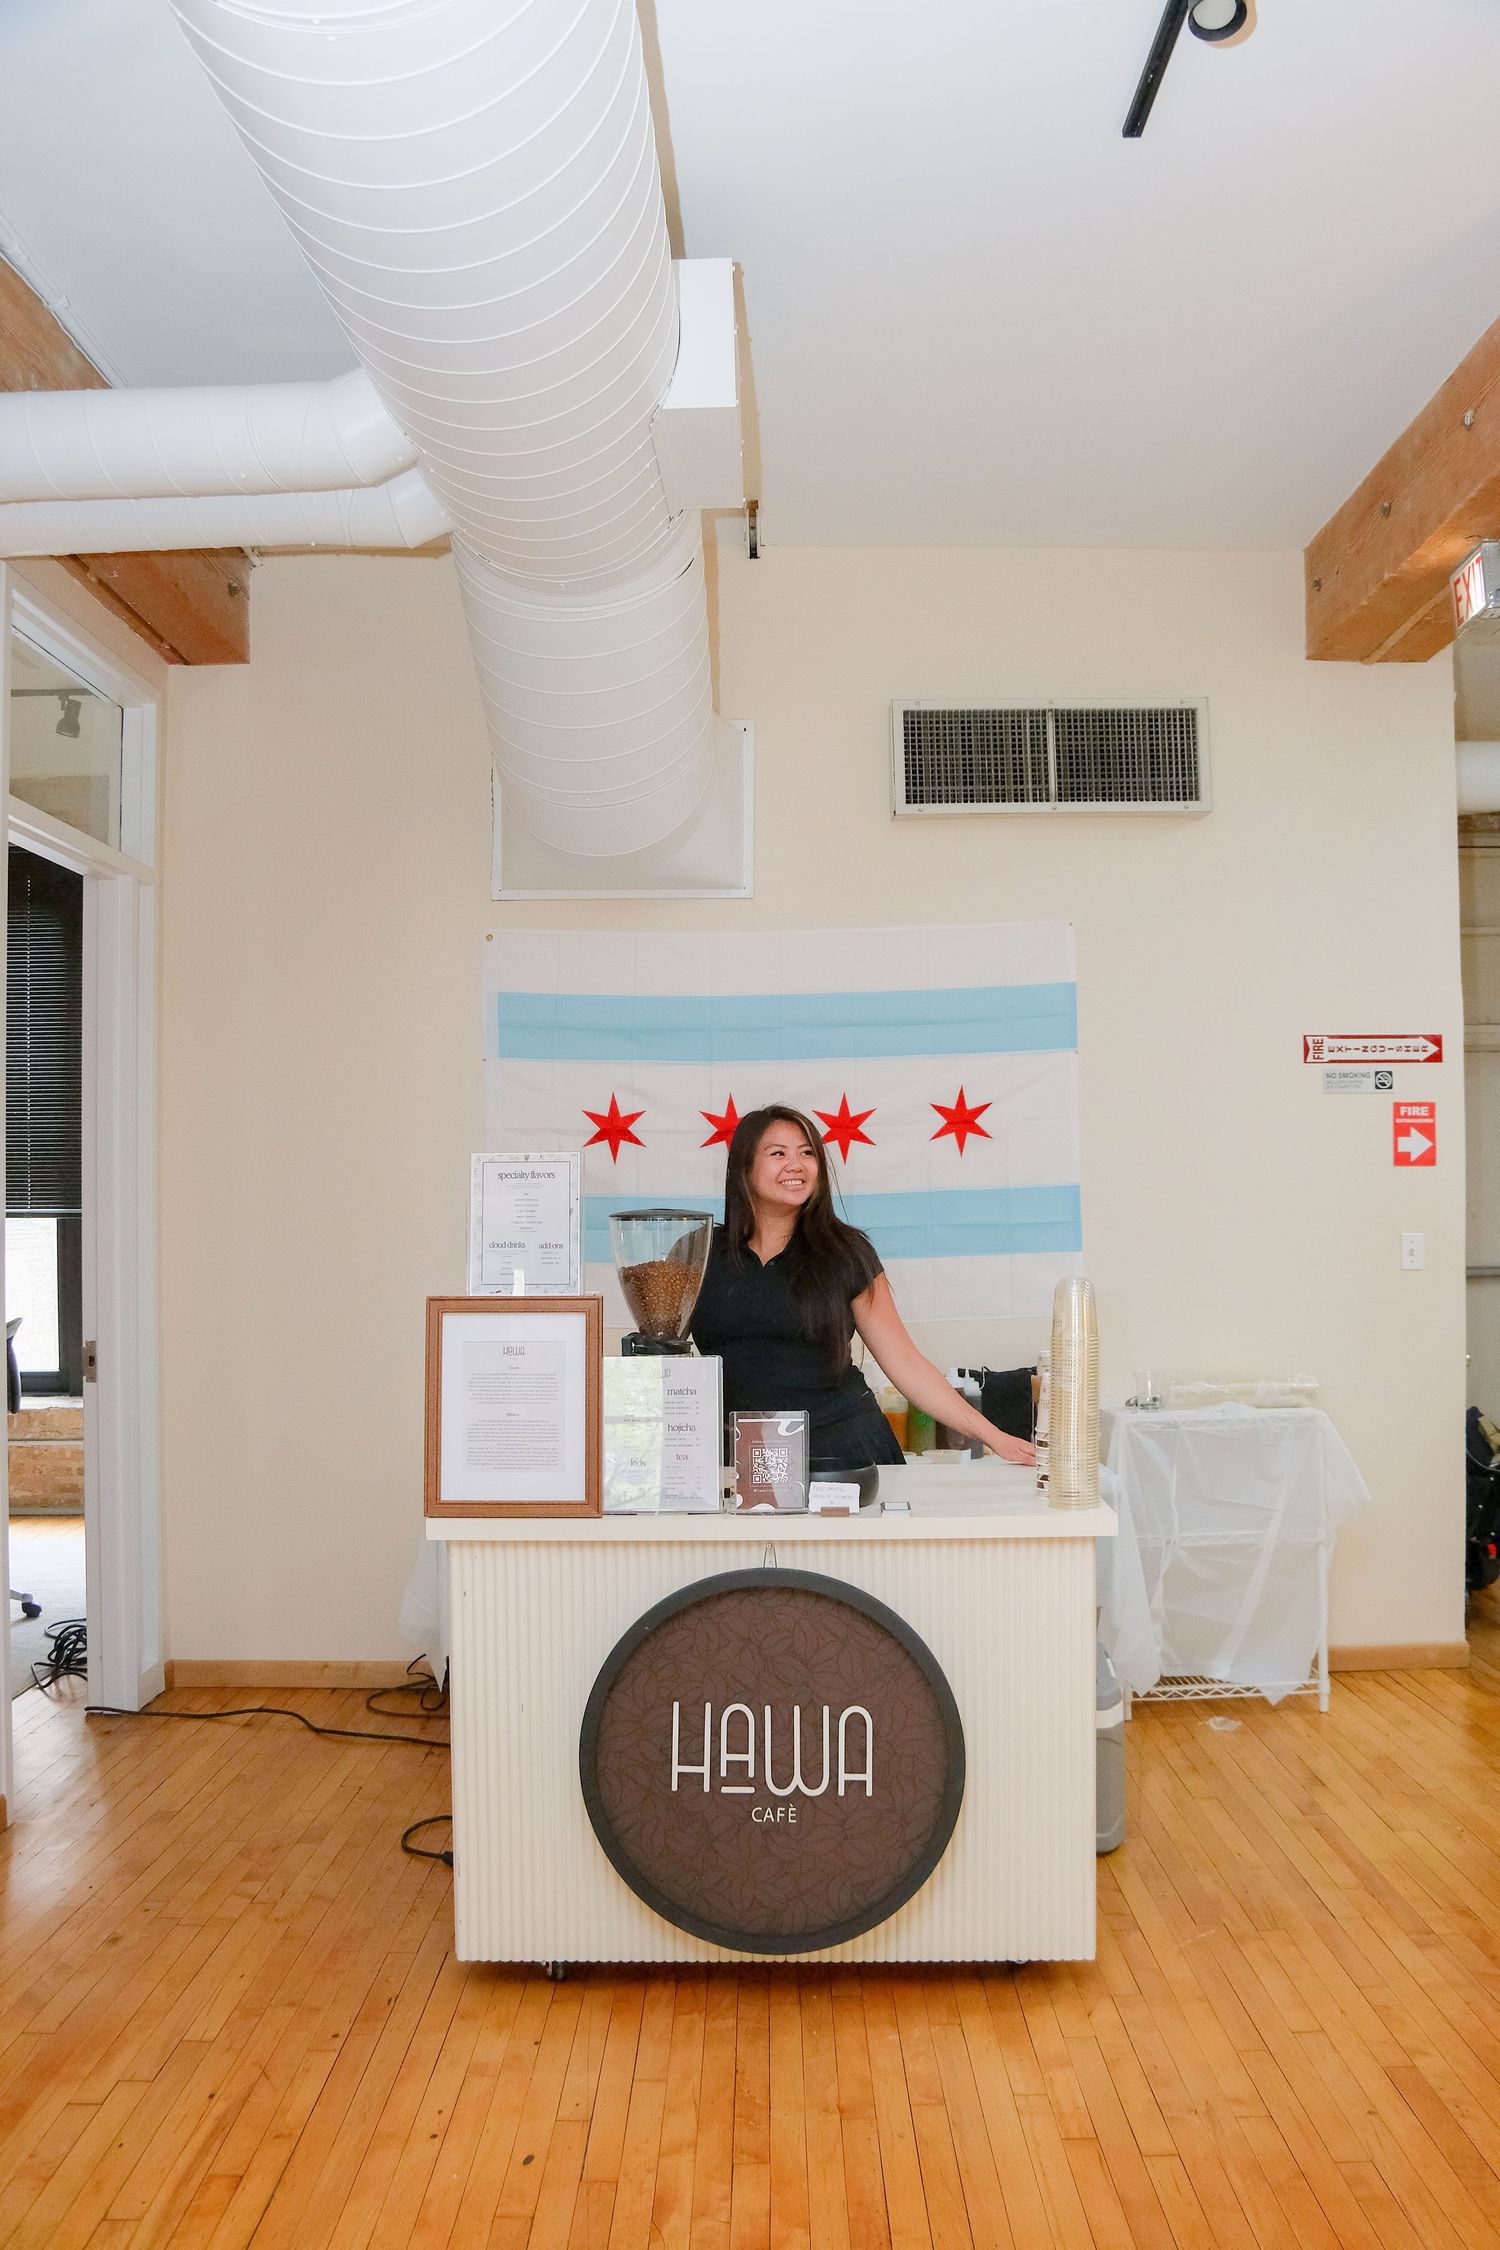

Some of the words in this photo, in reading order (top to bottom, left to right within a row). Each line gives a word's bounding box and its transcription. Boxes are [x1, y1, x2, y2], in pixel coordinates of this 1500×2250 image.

[1453, 556, 1484, 627] EXIT
[1313, 1038, 1324, 1060] FIRE
[1328, 1045, 1428, 1053] EXTINGUISHER
[1400, 1106, 1429, 1116] FIRE
[497, 1170, 530, 1181] specialty
[530, 1170, 556, 1180] flavors
[488, 1241, 506, 1249] cloud
[506, 1241, 526, 1249] drinks
[538, 1241, 564, 1250] add-ons
[503, 1345, 525, 1356] HAWA
[667, 1387, 696, 1396] matcha
[667, 1423, 696, 1434] hojicha
[675, 1453, 688, 1461] tea
[671, 1701, 873, 1797] HAWA
